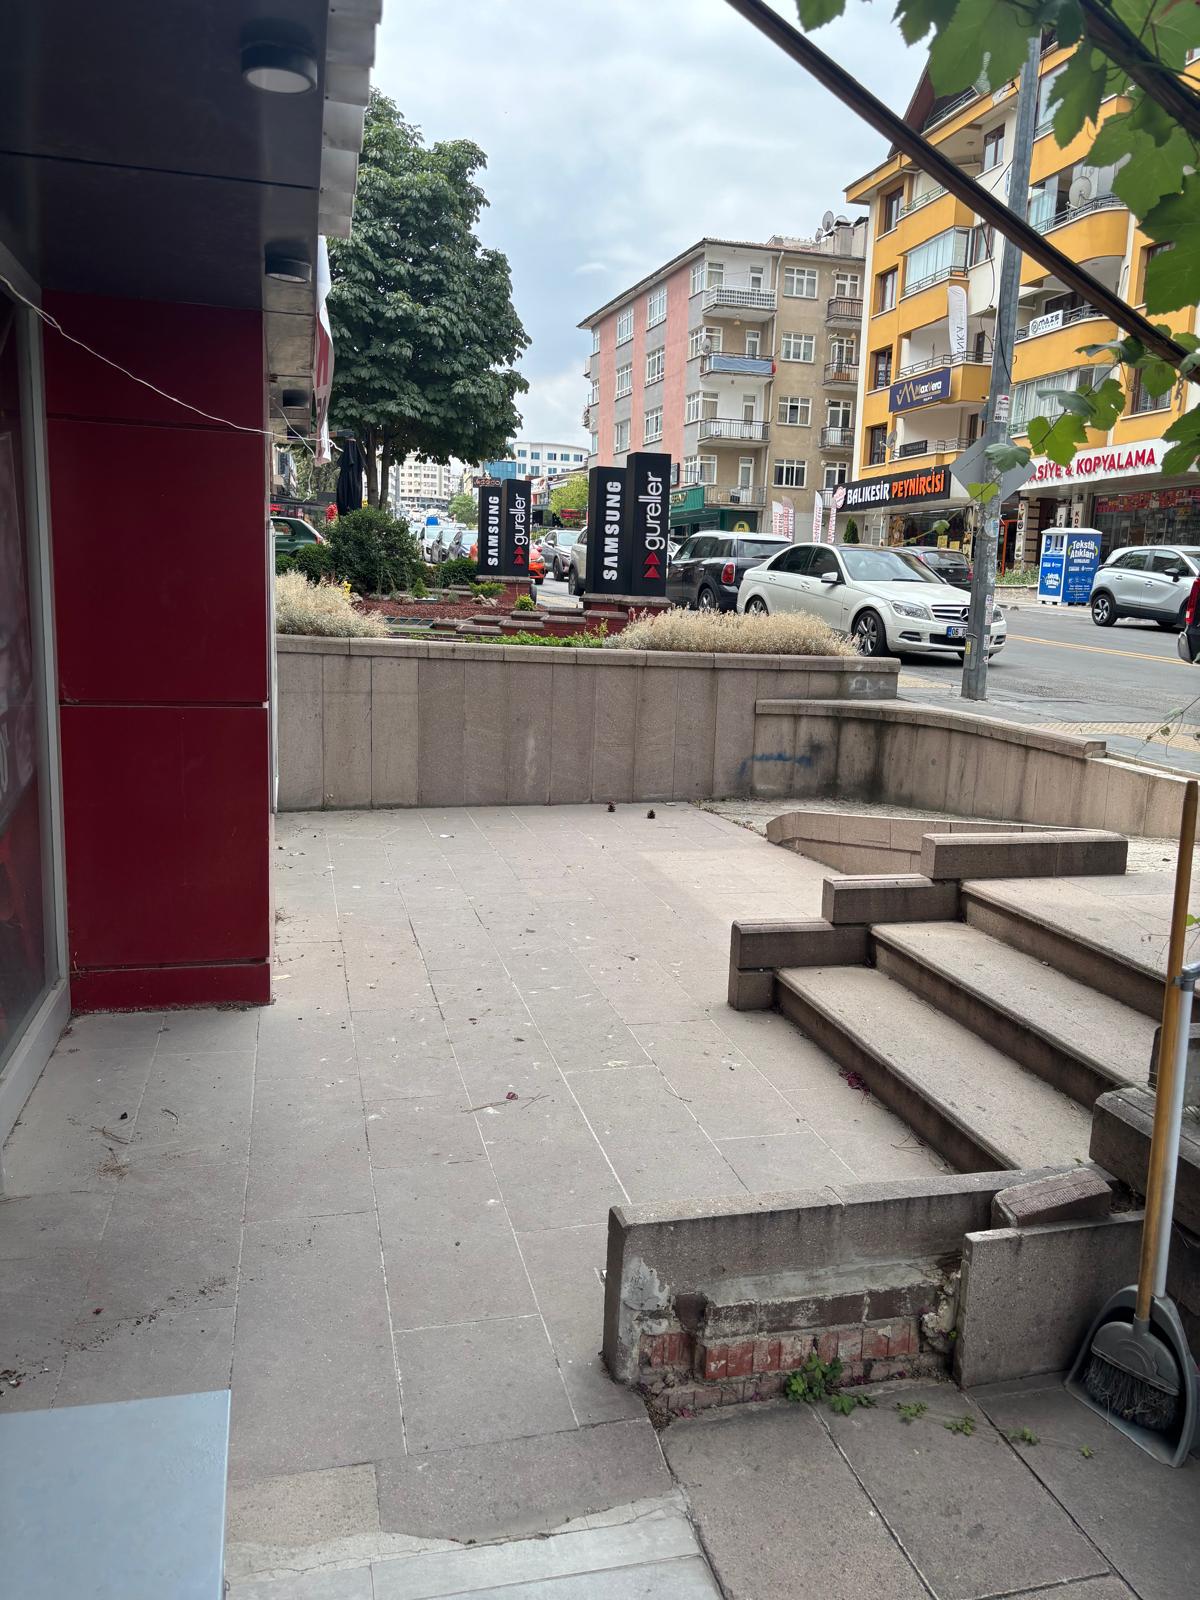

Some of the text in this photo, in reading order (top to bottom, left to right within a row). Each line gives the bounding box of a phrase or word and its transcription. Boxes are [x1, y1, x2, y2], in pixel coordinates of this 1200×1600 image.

[847, 468, 945, 505] BALIKESİR PEYNİRCİSİ
[1065, 464, 1073, 476] &
[1076, 448, 1156, 475] KOPYALAMA
[488, 496, 500, 566] SAMSUNG
[509, 493, 528, 545] gureller
[603, 481, 622, 580] SAMSUNG
[638, 471, 665, 550] gureller
[1072, 540, 1095, 551] Tekstil
